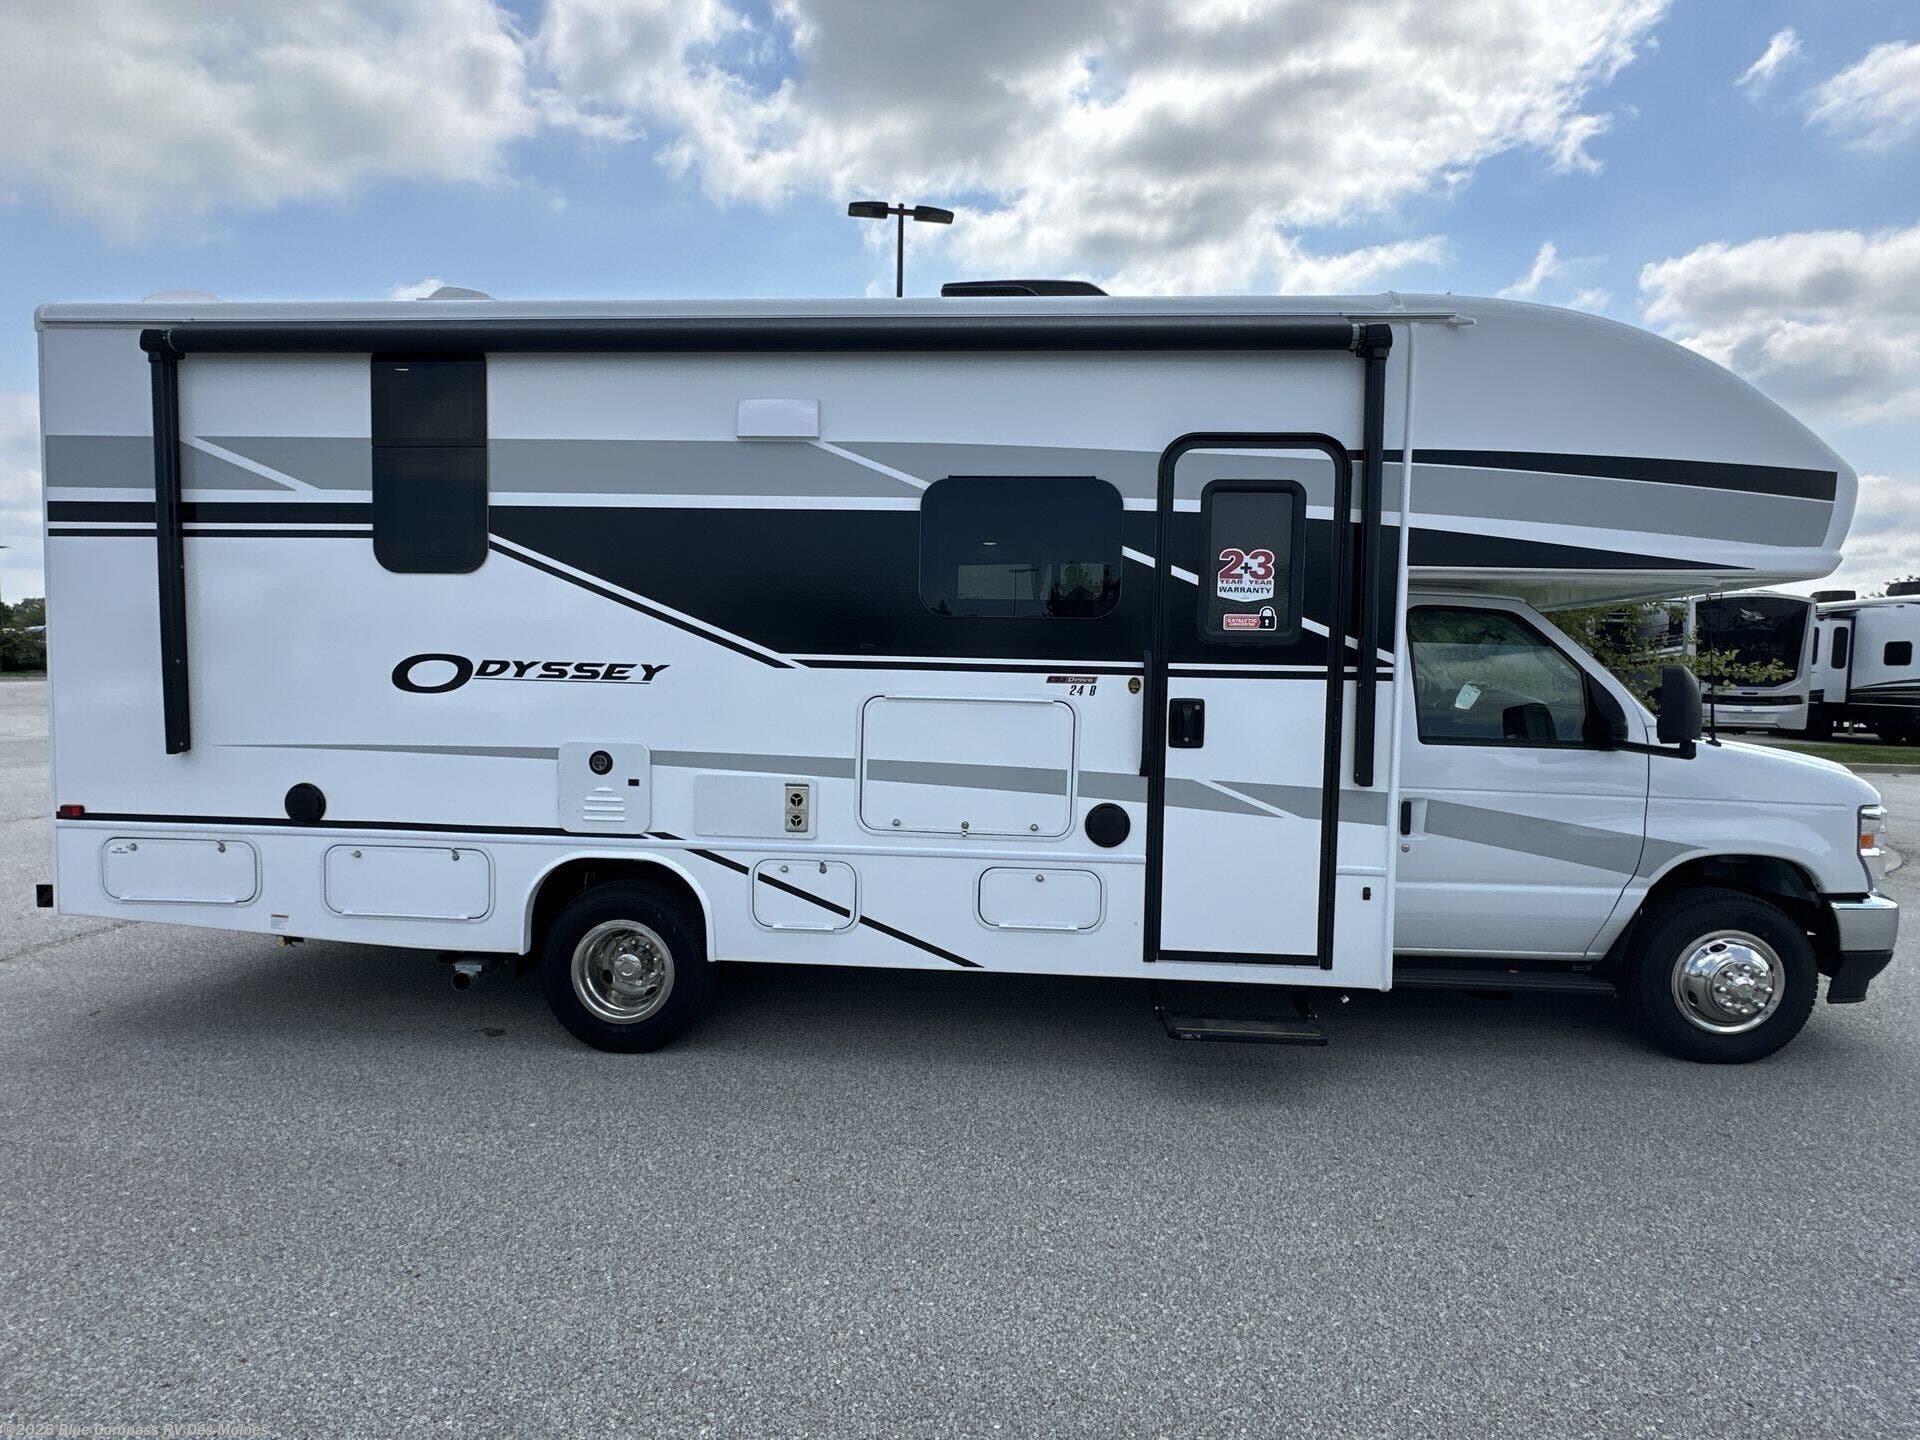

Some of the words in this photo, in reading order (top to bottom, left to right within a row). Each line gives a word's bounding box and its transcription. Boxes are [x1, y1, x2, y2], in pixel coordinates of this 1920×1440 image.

[1219, 586, 1272, 594] WARRANTY
[391, 653, 671, 694] ODYSSEY
[1070, 684, 1084, 696] 24
[1089, 685, 1097, 696] B
